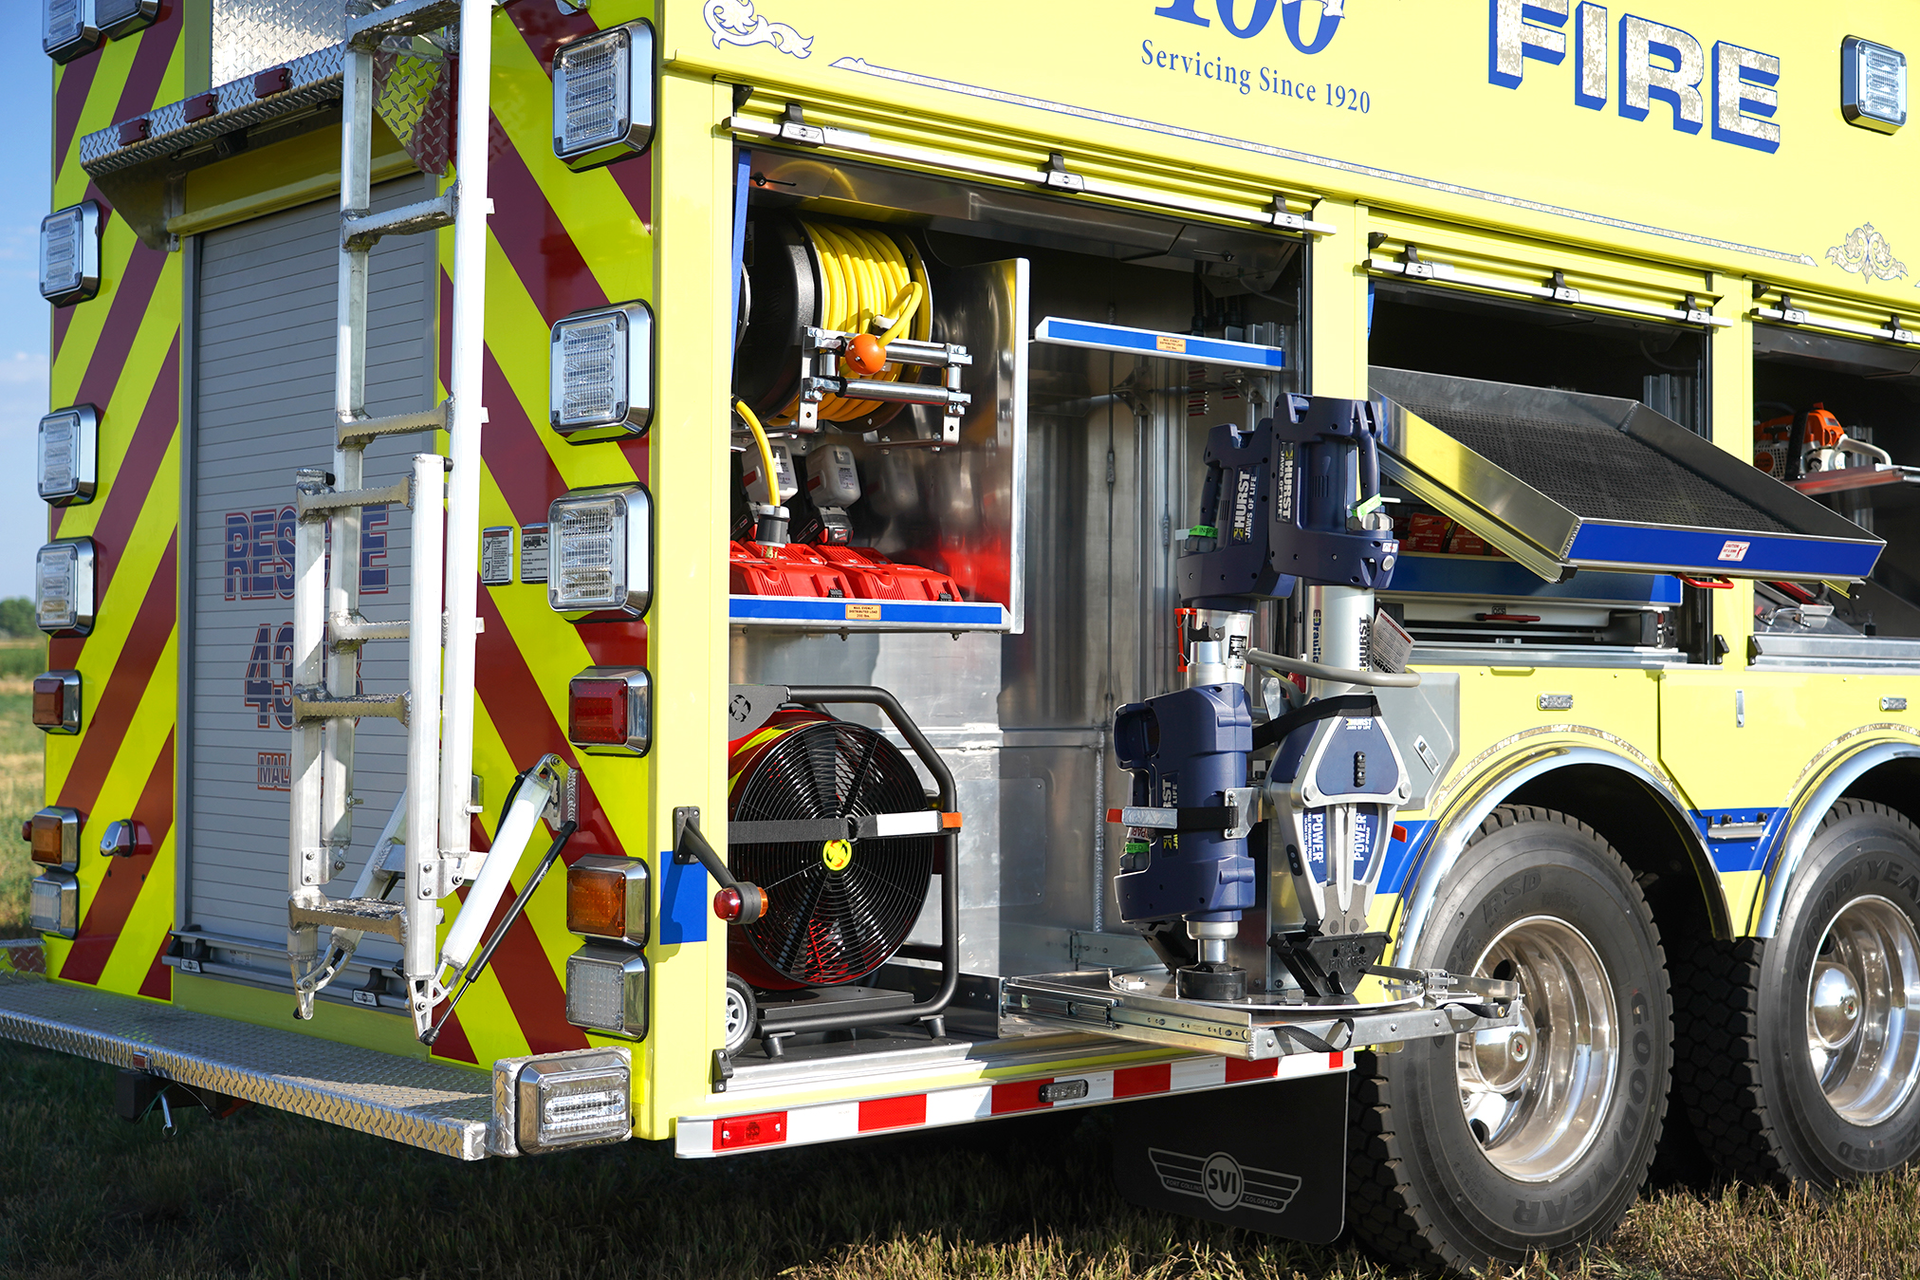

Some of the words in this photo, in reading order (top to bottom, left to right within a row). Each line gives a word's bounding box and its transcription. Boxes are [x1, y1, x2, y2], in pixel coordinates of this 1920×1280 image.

[1141, 39, 1251, 95] Servicing
[1259, 66, 1316, 102] Since
[1325, 83, 1371, 114] 1920
[1488, 0, 1780, 155] FIRE
[1234, 471, 1250, 528] HURST
[1247, 497, 1255, 510] OF
[1249, 476, 1257, 495] LIFE
[1282, 460, 1293, 519] HURST
[1245, 512, 1253, 539] JAWS
[225, 504, 389, 601] RESE
[1359, 617, 1367, 667] HURST
[1798, 859, 1920, 983] GOODYEA
[1166, 1179, 1180, 1188] FORT
[1180, 1181, 1203, 1192] COLLINS
[1244, 1195, 1278, 1208] COLORADO
[1208, 1168, 1237, 1195] SVI
